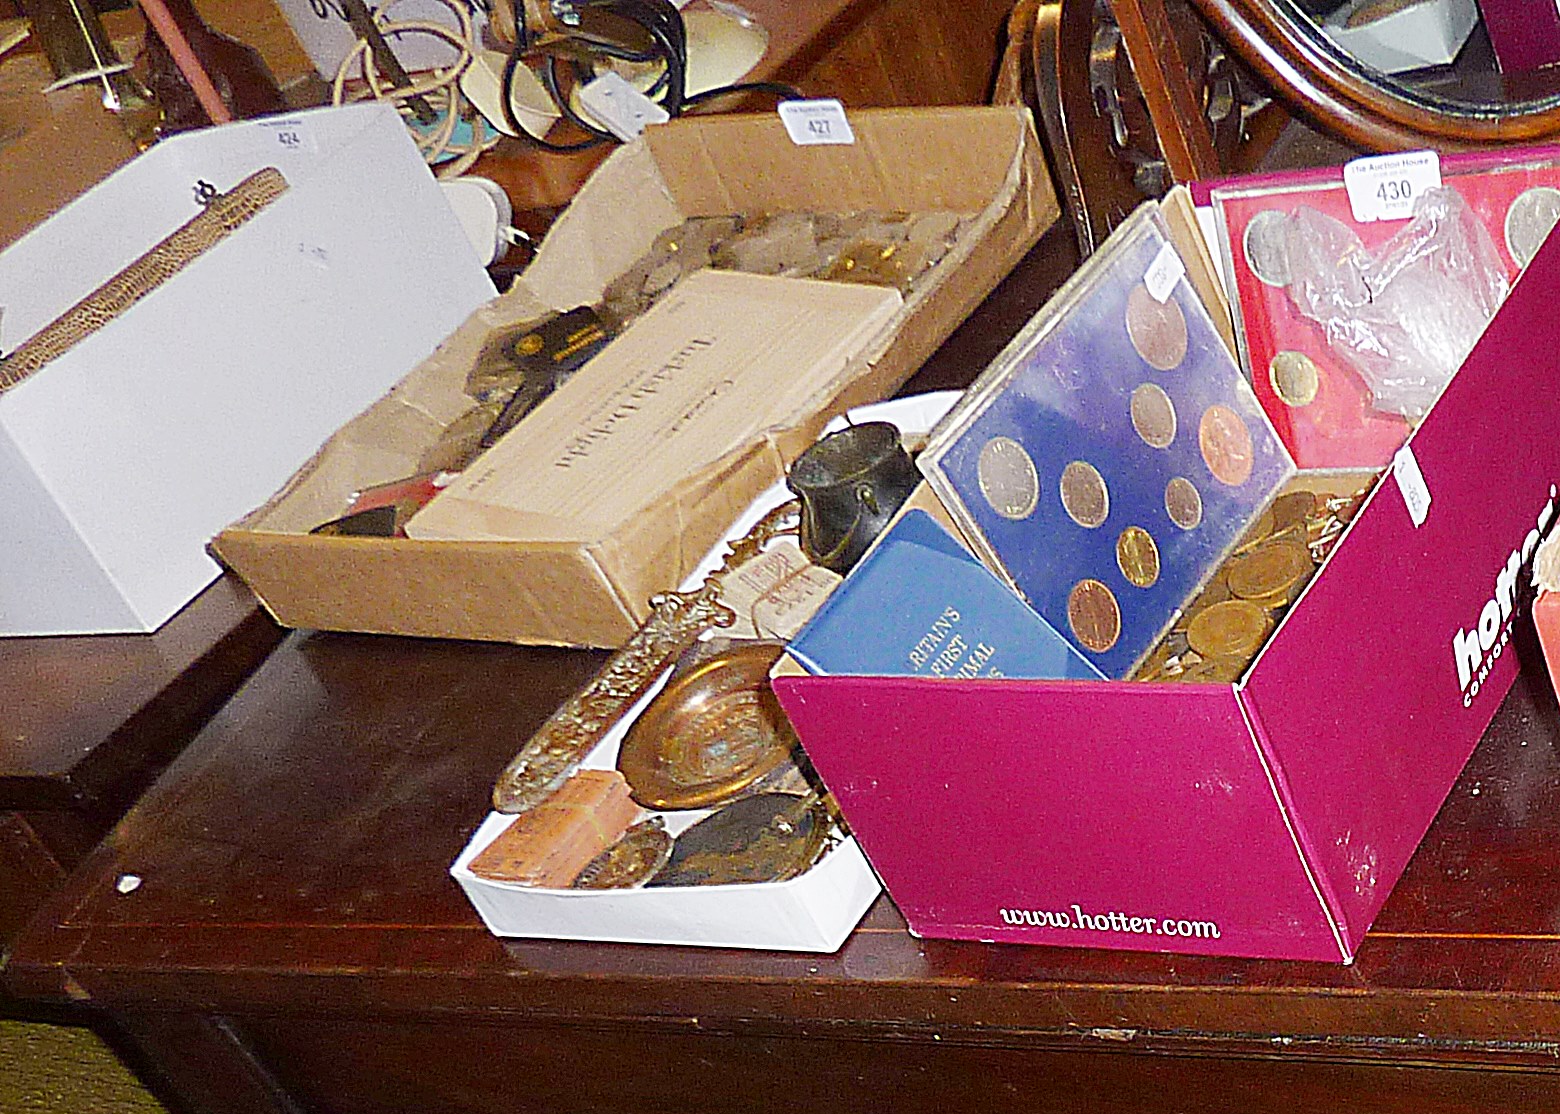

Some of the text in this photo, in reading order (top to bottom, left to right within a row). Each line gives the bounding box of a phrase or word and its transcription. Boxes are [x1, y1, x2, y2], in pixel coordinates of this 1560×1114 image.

[808, 120, 831, 134] 427
[1376, 180, 1411, 201] 430
[908, 606, 961, 671] RITAIN'S
[930, 634, 969, 678] FIRST
[954, 642, 996, 679] IMAL
[1463, 621, 1513, 708] COMFORT
[1000, 904, 1221, 939] www.hotter.com
